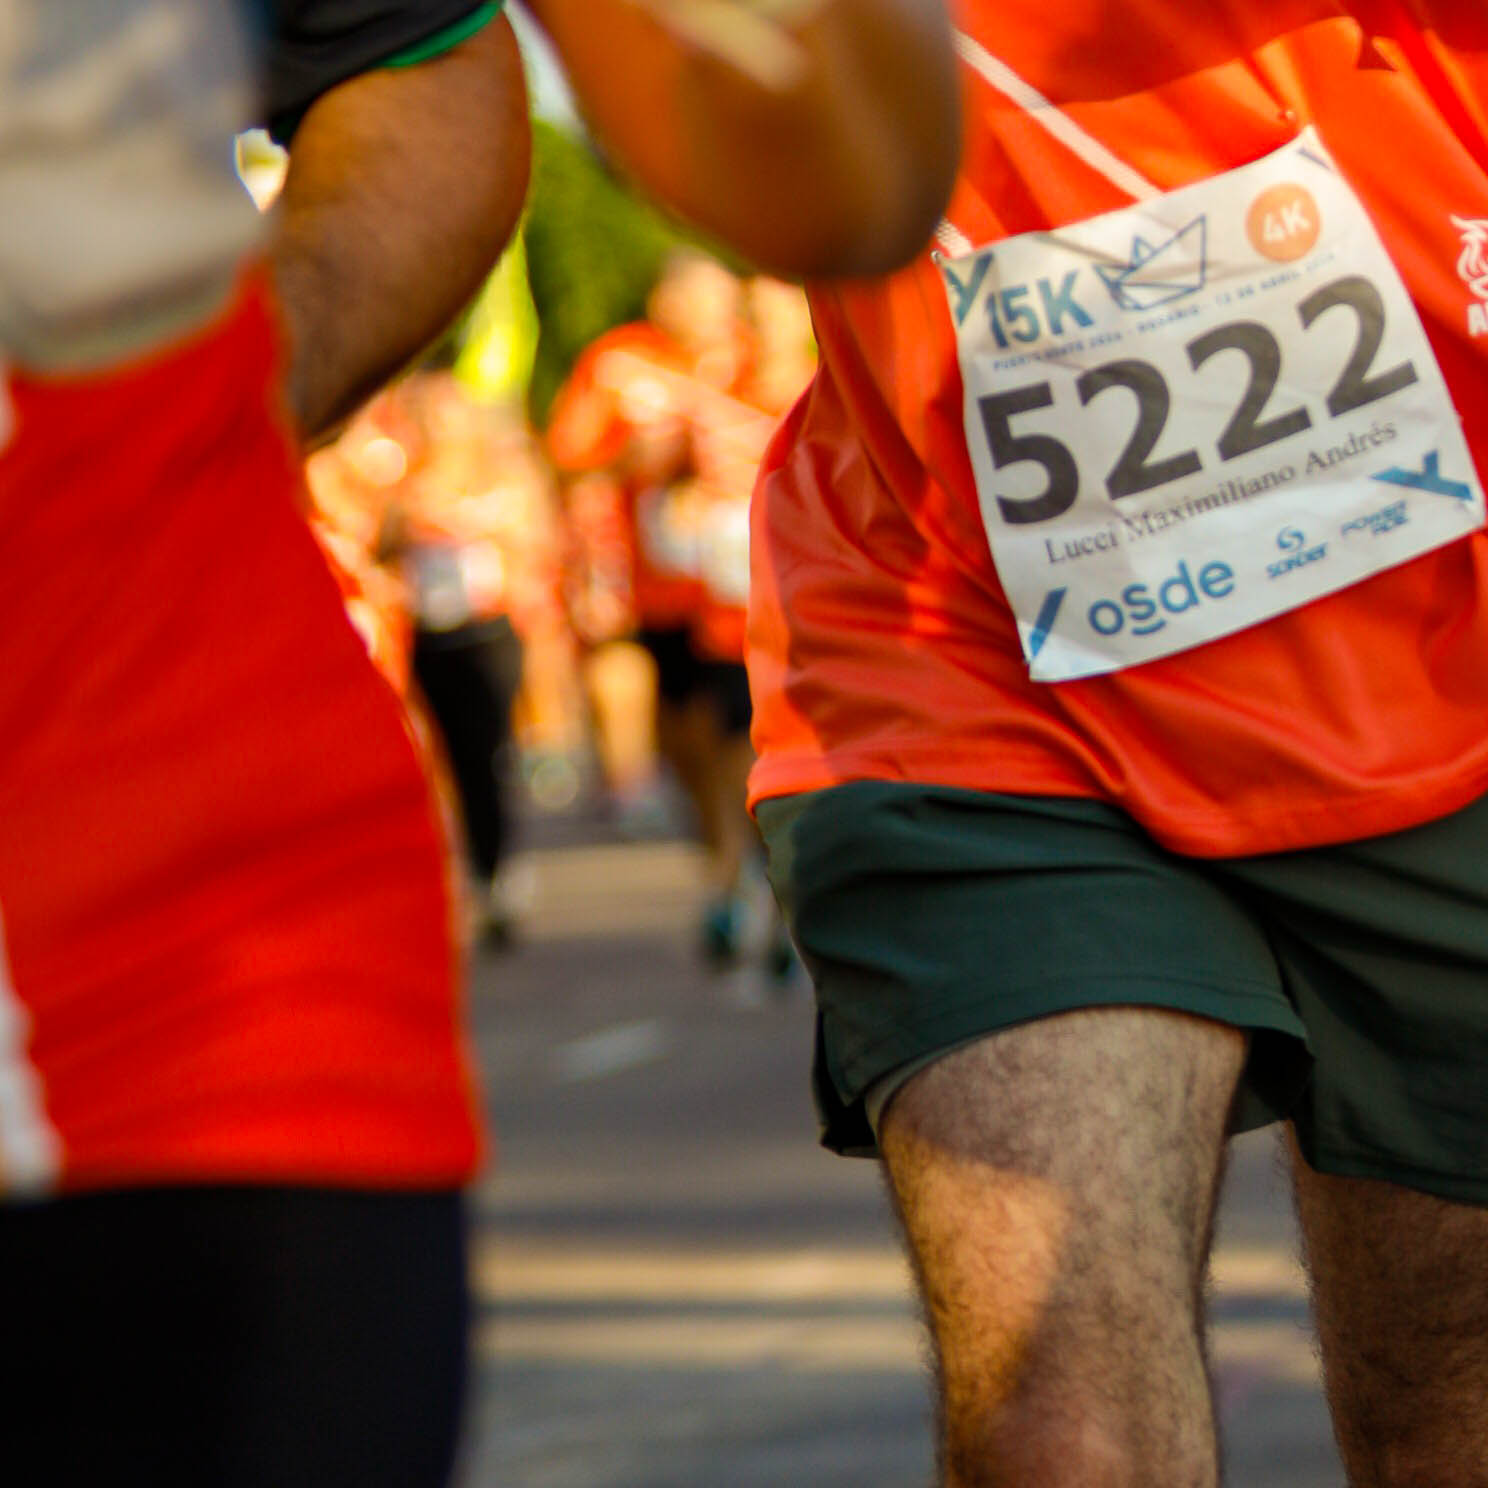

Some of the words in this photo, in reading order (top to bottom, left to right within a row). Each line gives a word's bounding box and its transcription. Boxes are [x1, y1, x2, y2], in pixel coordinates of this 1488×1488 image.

[1262, 199, 1311, 244] 4K
[986, 269, 1094, 349] 15K
[979, 273, 1419, 524] 5222
[1045, 525, 1120, 564] Lucci
[1122, 465, 1297, 543] Maximiliano
[1305, 421, 1398, 476] Andrés
[1087, 559, 1235, 637] osde
